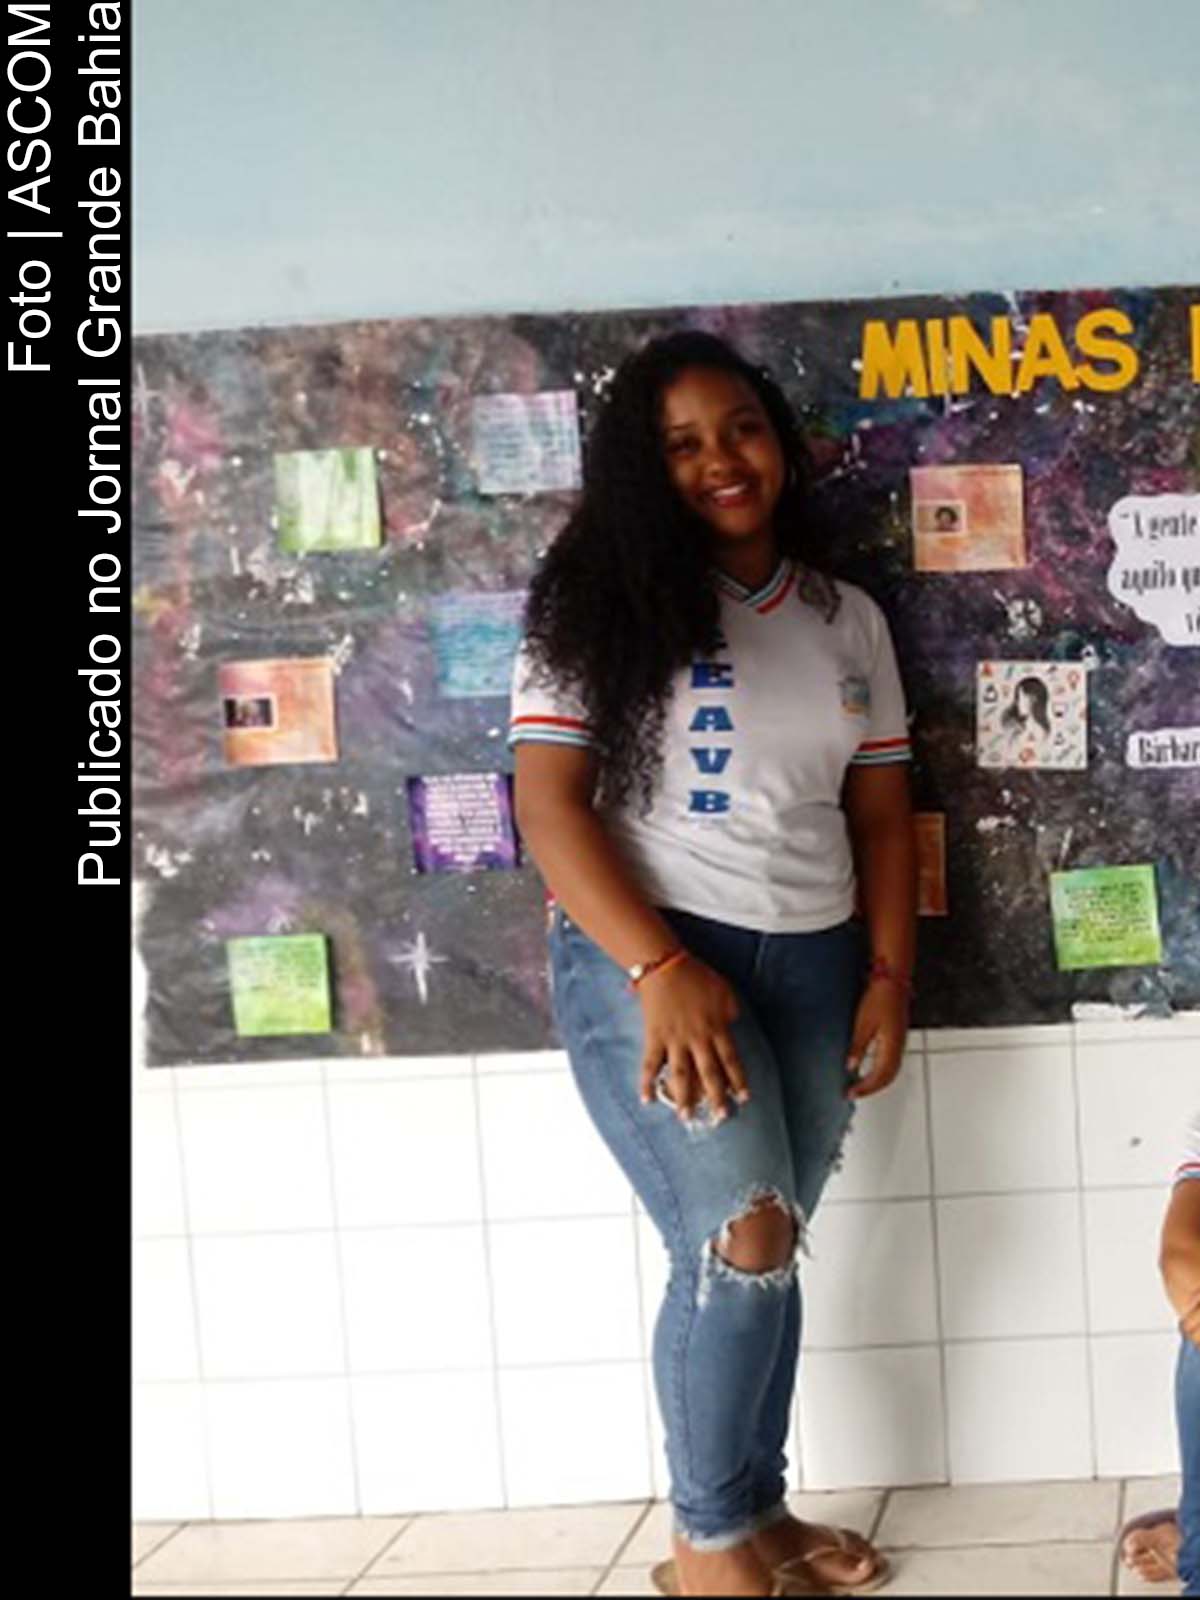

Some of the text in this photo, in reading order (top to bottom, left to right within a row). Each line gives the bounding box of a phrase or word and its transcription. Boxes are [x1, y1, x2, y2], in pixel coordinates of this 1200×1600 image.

[859, 308, 1140, 399] MINAS
[1148, 512, 1197, 542] gente
[1121, 560, 1176, 596] aquilo
[689, 660, 736, 813] EAVB
